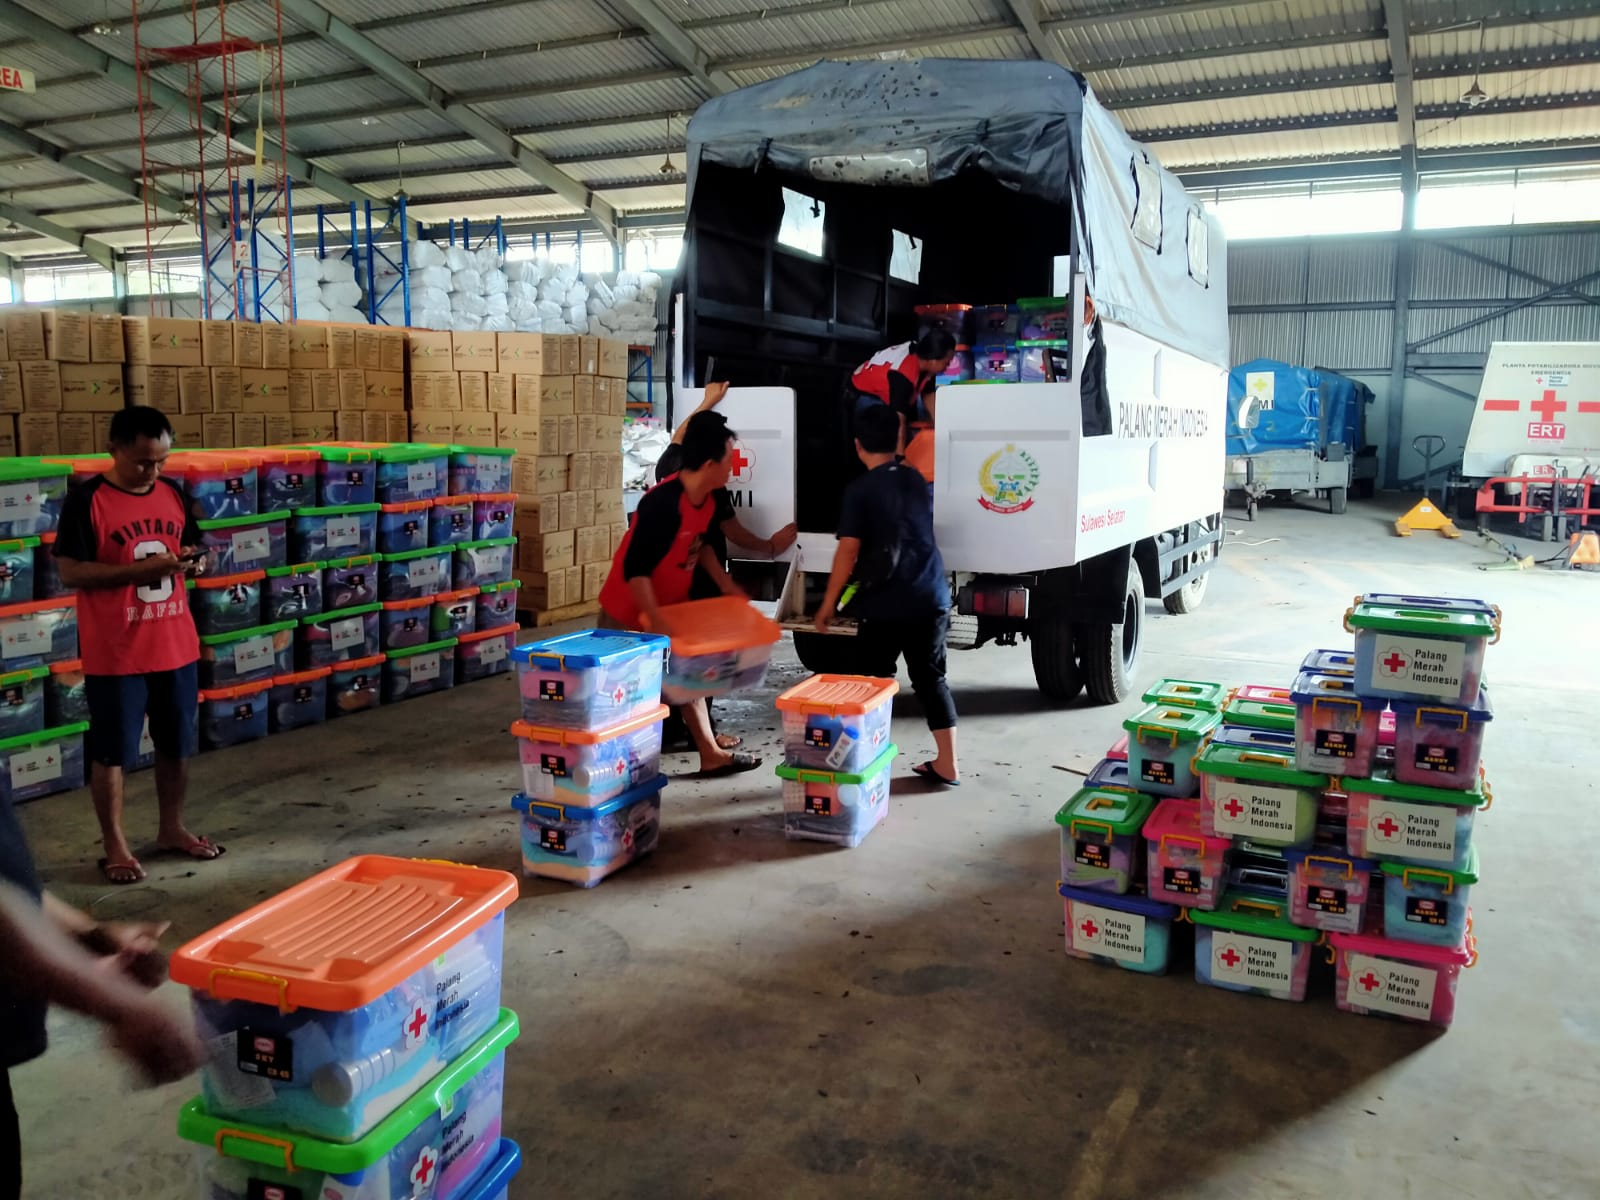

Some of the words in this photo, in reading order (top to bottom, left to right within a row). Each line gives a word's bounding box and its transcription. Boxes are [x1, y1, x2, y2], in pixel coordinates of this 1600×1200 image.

[0, 67, 23, 89] EA
[1258, 399, 1274, 409] MI
[1118, 401, 1152, 439] PALANG
[1529, 424, 1564, 437] ERT
[727, 490, 752, 508] MI
[1081, 511, 1106, 533] Sulawesi
[1415, 649, 1447, 662] Palang
[1413, 661, 1444, 672] Merah
[1412, 673, 1458, 686] Indonesia
[1252, 796, 1281, 808] Palang
[1251, 807, 1279, 818] Merah
[1251, 818, 1293, 830] Indonesia
[1408, 815, 1440, 827] Palang
[1407, 826, 1437, 837] Merah
[1406, 837, 1452, 850] Indonesia
[1105, 919, 1131, 932] Palang
[1105, 929, 1129, 940] Merah
[1105, 939, 1142, 952] Indonesia
[1248, 946, 1277, 959] Palang
[1248, 957, 1275, 968] Merah
[1247, 968, 1288, 980] Indonesia
[1389, 972, 1420, 987] Palang
[436, 971, 460, 995] Palang
[1388, 984, 1416, 996] Merah
[436, 990, 458, 1012] Merah
[1386, 993, 1429, 1009] Indonesia
